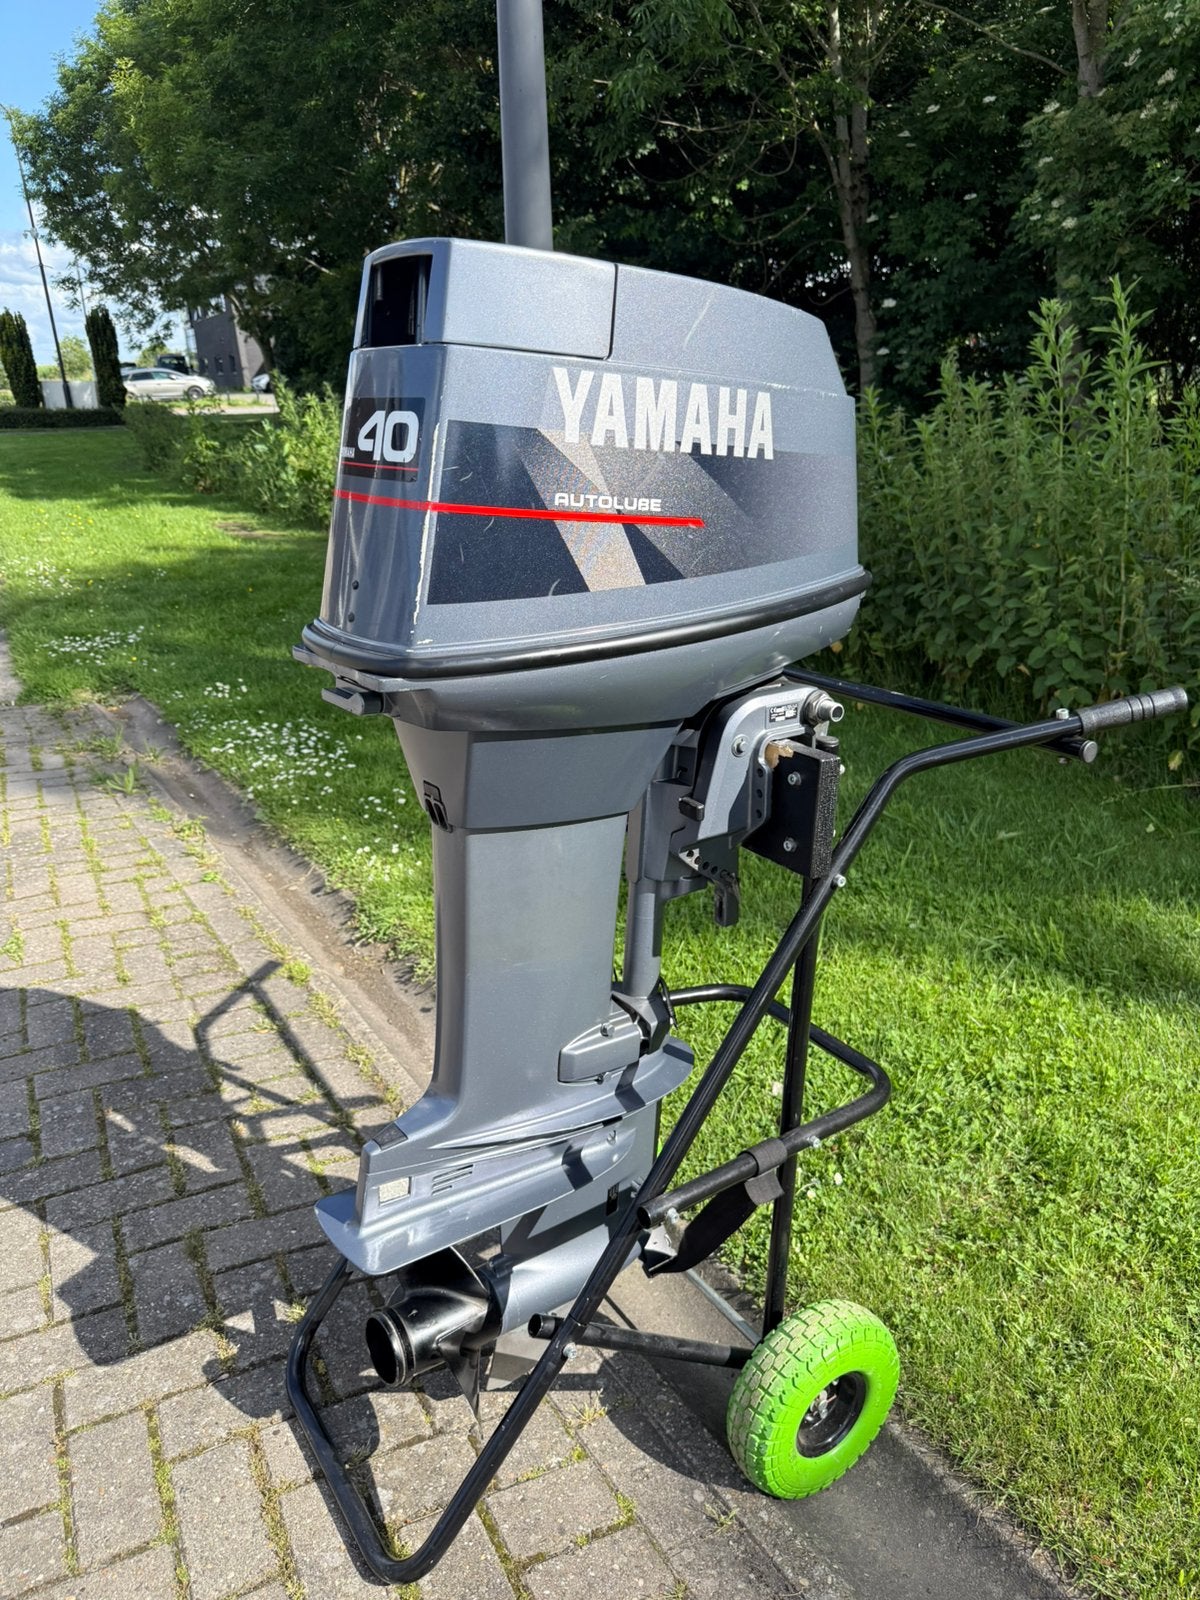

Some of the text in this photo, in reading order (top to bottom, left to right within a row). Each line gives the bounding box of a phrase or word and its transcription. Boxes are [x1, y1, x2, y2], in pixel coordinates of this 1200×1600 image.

[357, 410, 420, 464] 40
[552, 366, 775, 461] YAMAHA
[554, 492, 662, 512] AUTOLUBE
